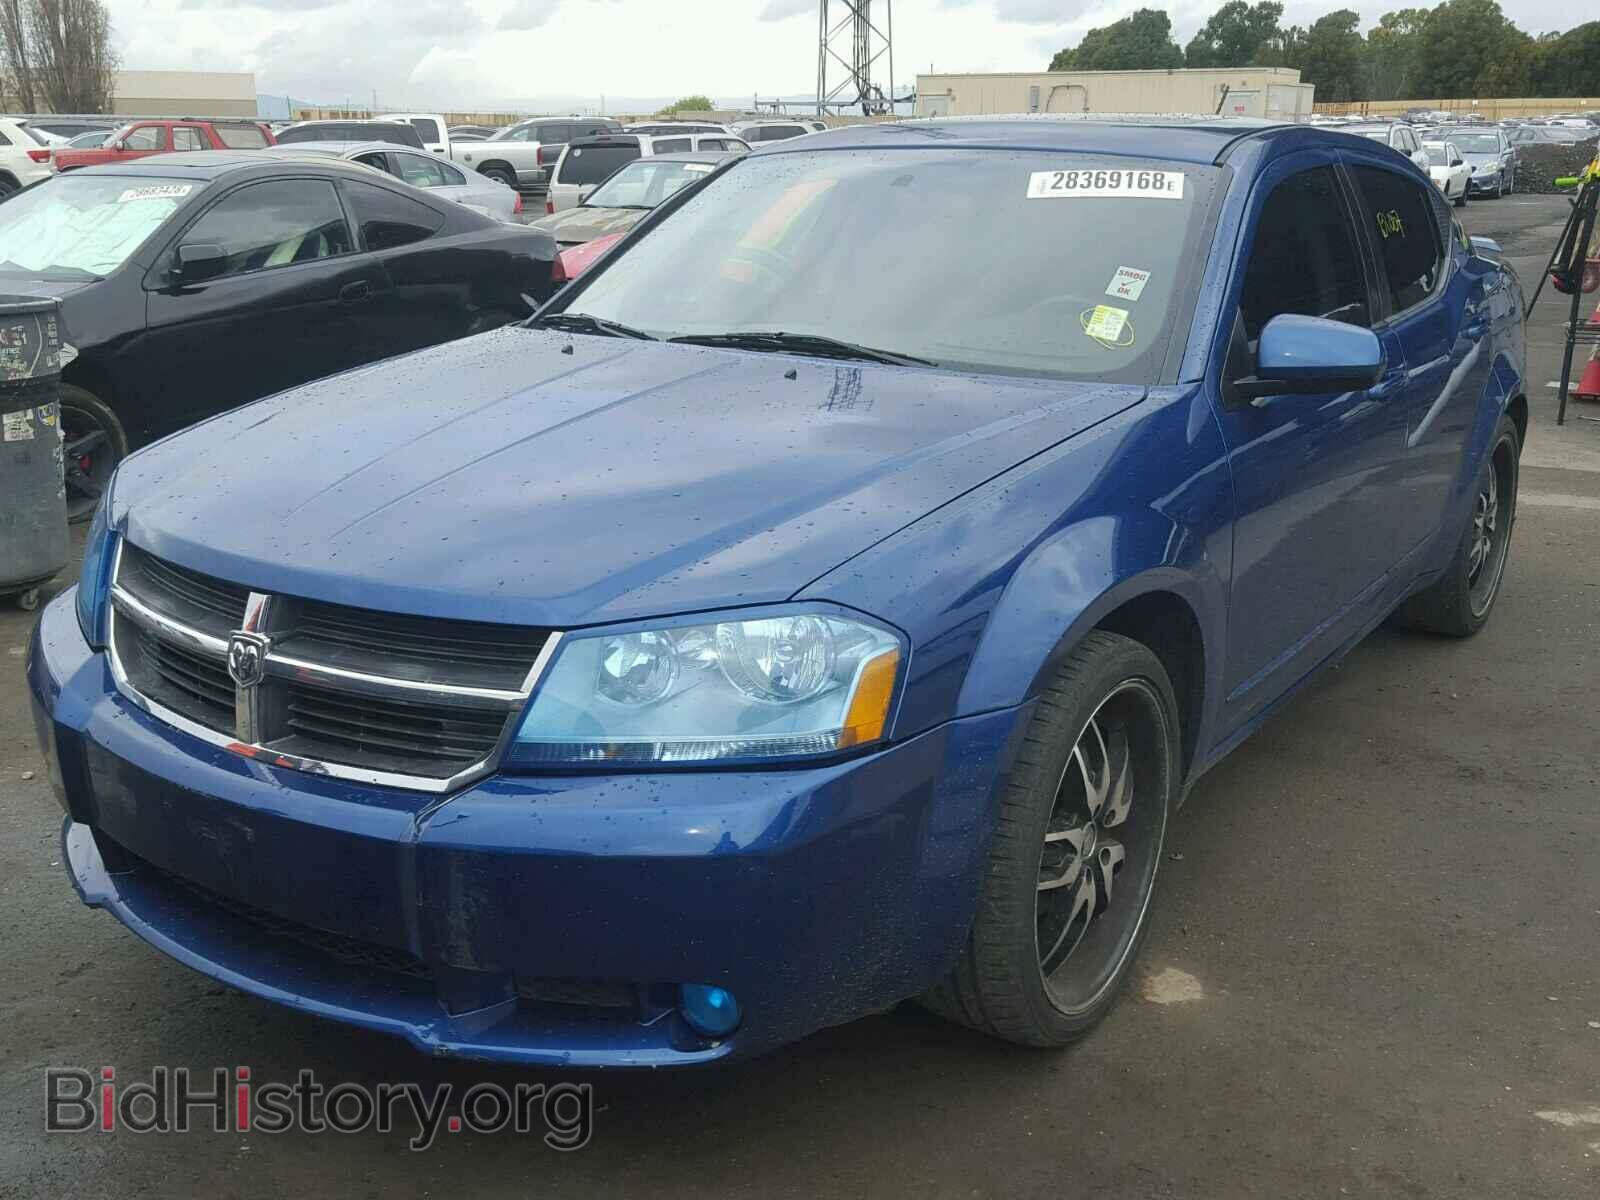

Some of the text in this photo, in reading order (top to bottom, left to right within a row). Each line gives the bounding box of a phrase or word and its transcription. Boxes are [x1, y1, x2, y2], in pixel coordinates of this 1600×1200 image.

[1050, 171, 1165, 190] 28369168
[1118, 269, 1147, 281] SMOG
[1116, 286, 1131, 295] OK
